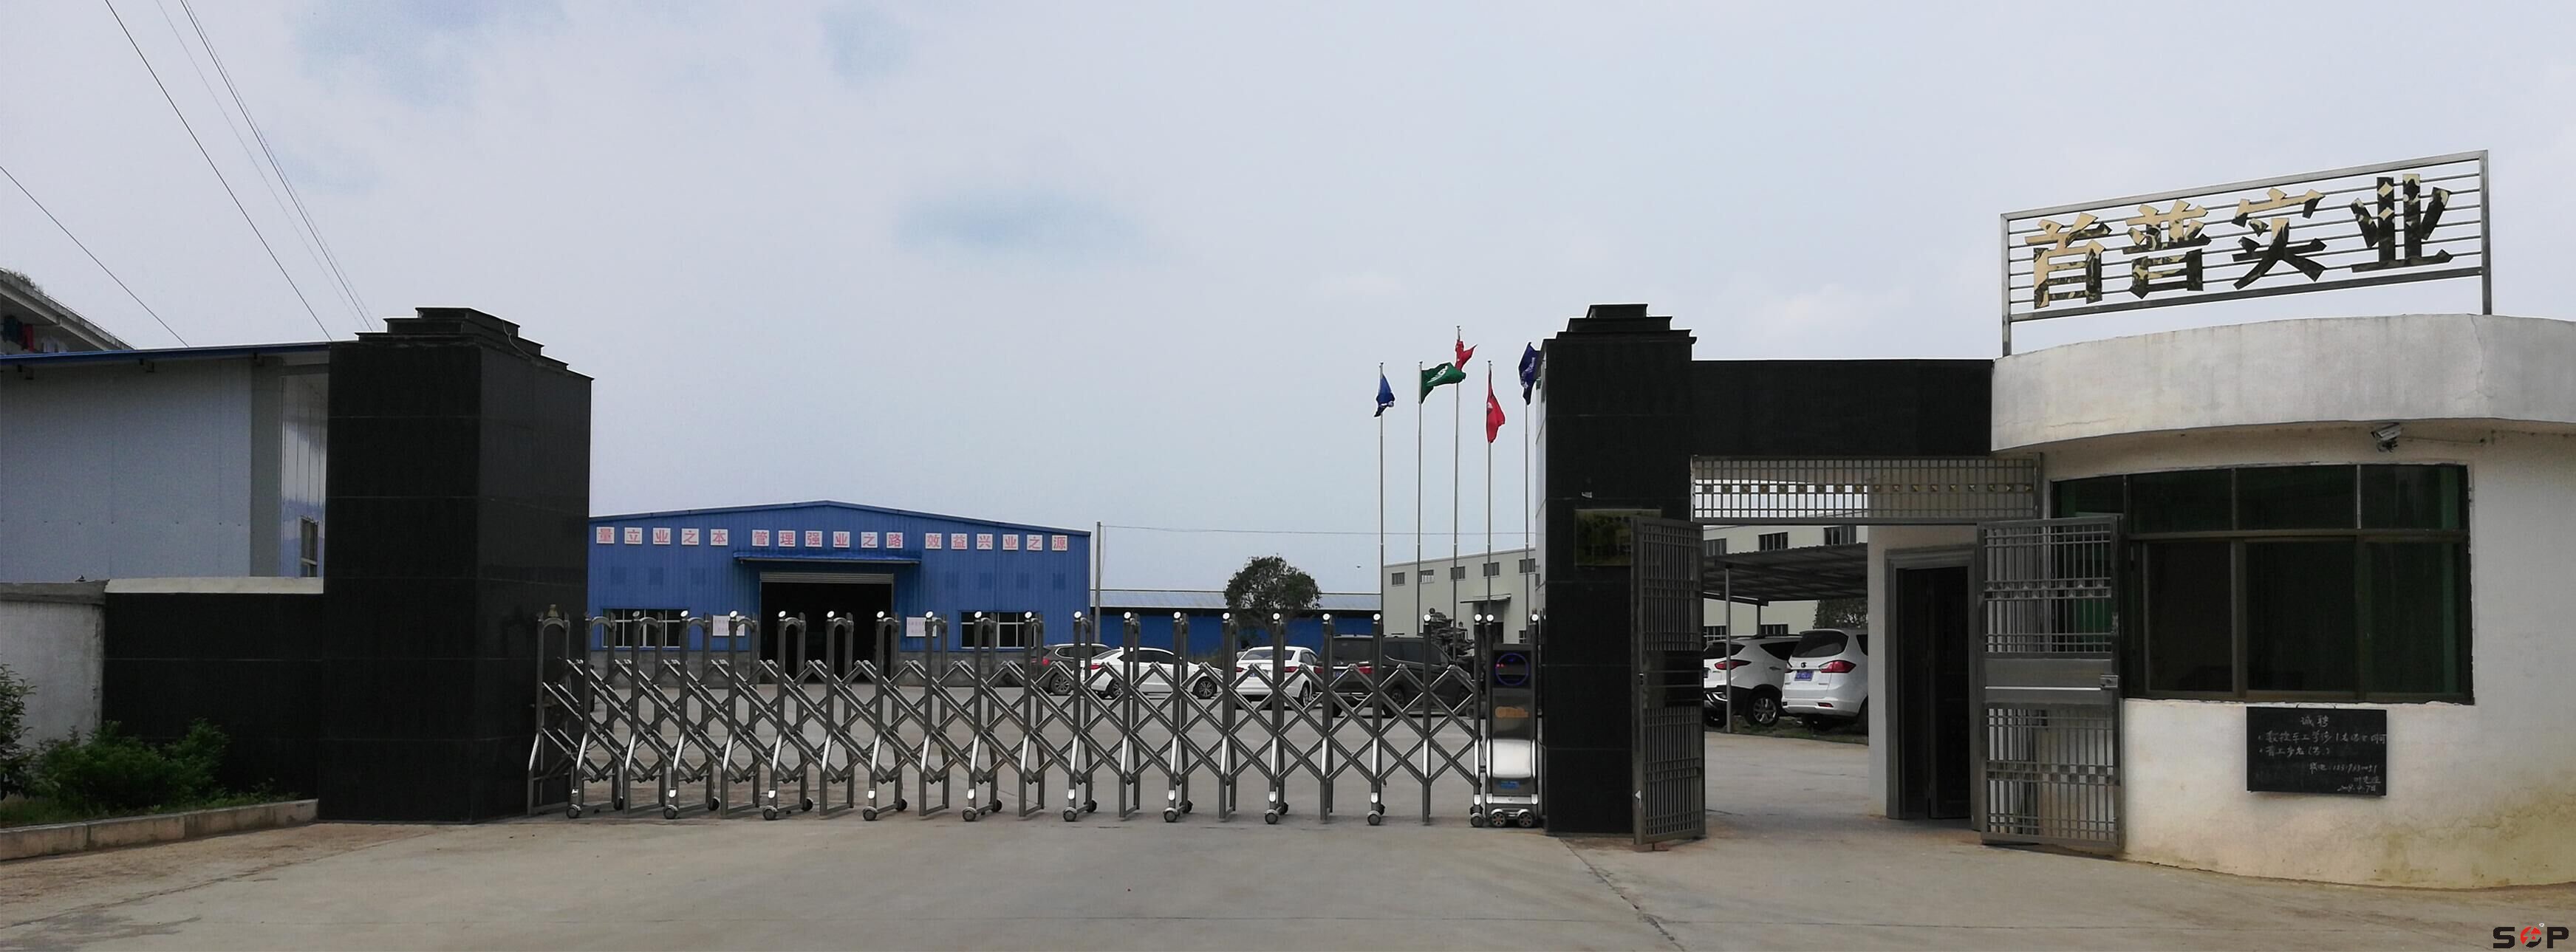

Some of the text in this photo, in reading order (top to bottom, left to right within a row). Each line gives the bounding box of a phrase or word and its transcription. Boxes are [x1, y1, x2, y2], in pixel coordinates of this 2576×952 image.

[2023, 173, 2453, 309] 首普实业
[752, 530, 903, 547] 管理强业之路
[926, 533, 1067, 550] 效益兴业之源
